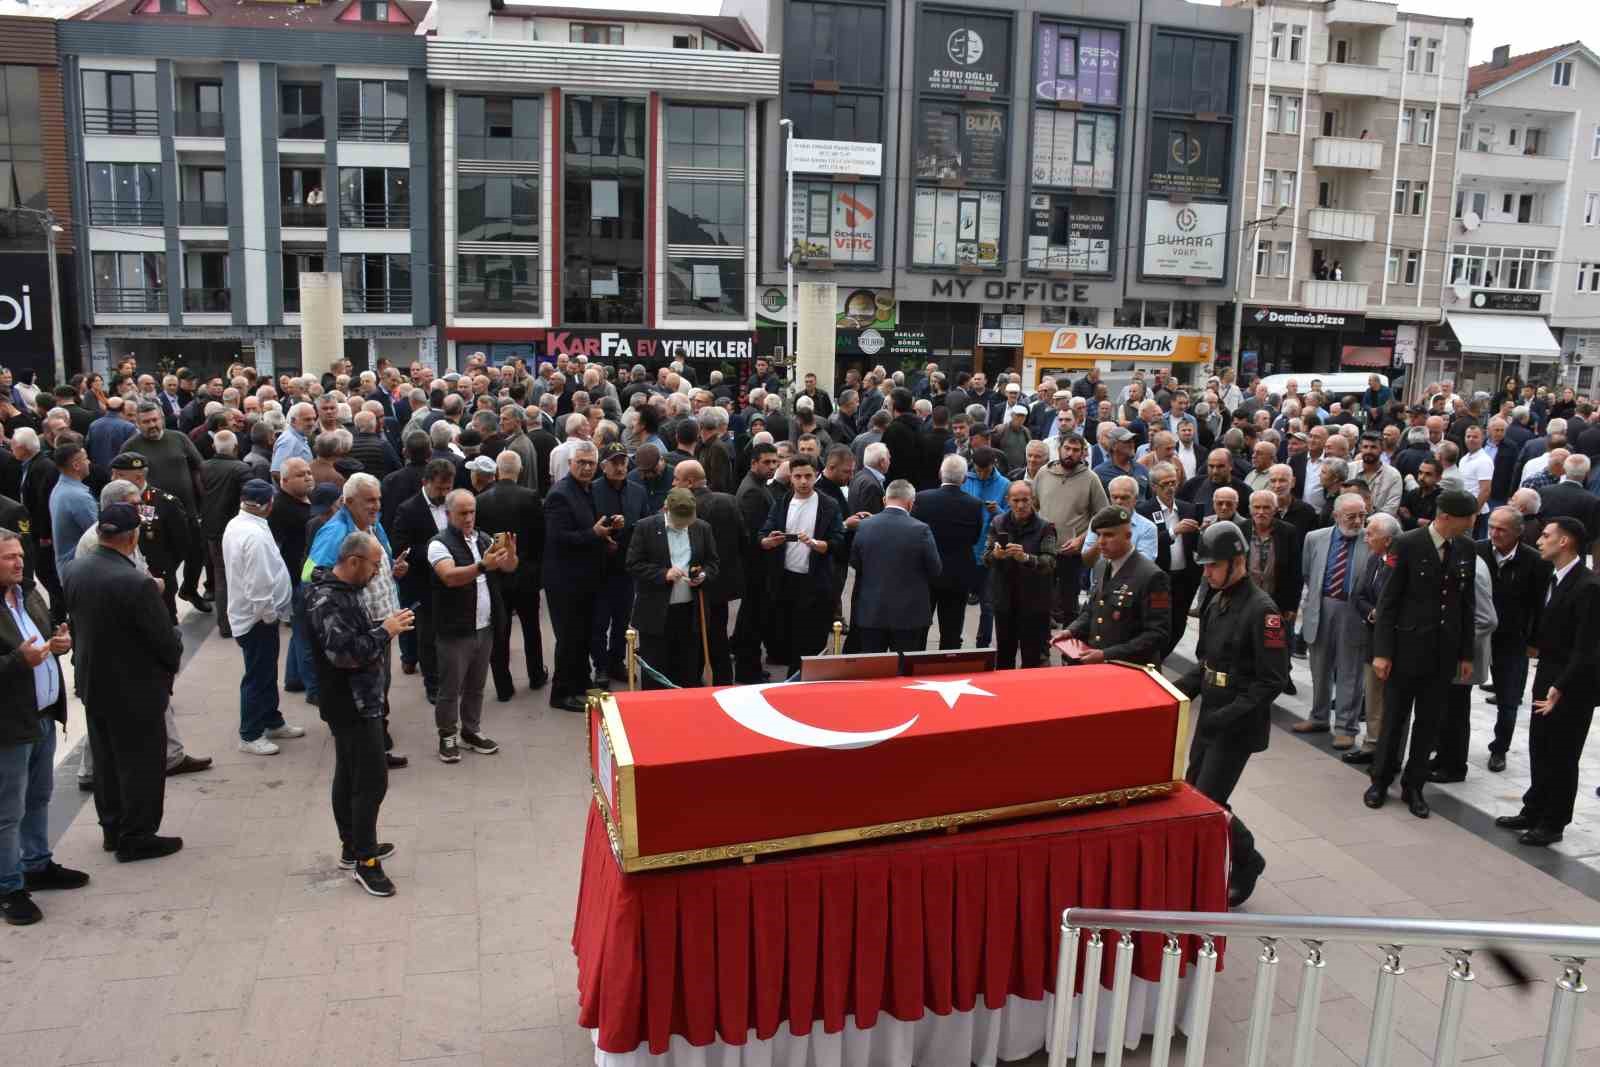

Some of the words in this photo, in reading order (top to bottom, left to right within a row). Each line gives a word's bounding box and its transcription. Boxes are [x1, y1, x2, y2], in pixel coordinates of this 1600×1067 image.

[1080, 57, 1117, 69] YAPI
[1157, 234, 1214, 248] BUHARA
[931, 278, 973, 297] MY
[984, 281, 1089, 302] OFFICE
[1268, 311, 1316, 324] Domino's
[1316, 314, 1345, 325] Pizza
[637, 339, 656, 357] EV
[661, 337, 753, 358] YEMEKLERİ
[1085, 332, 1172, 352] VakıfBank
